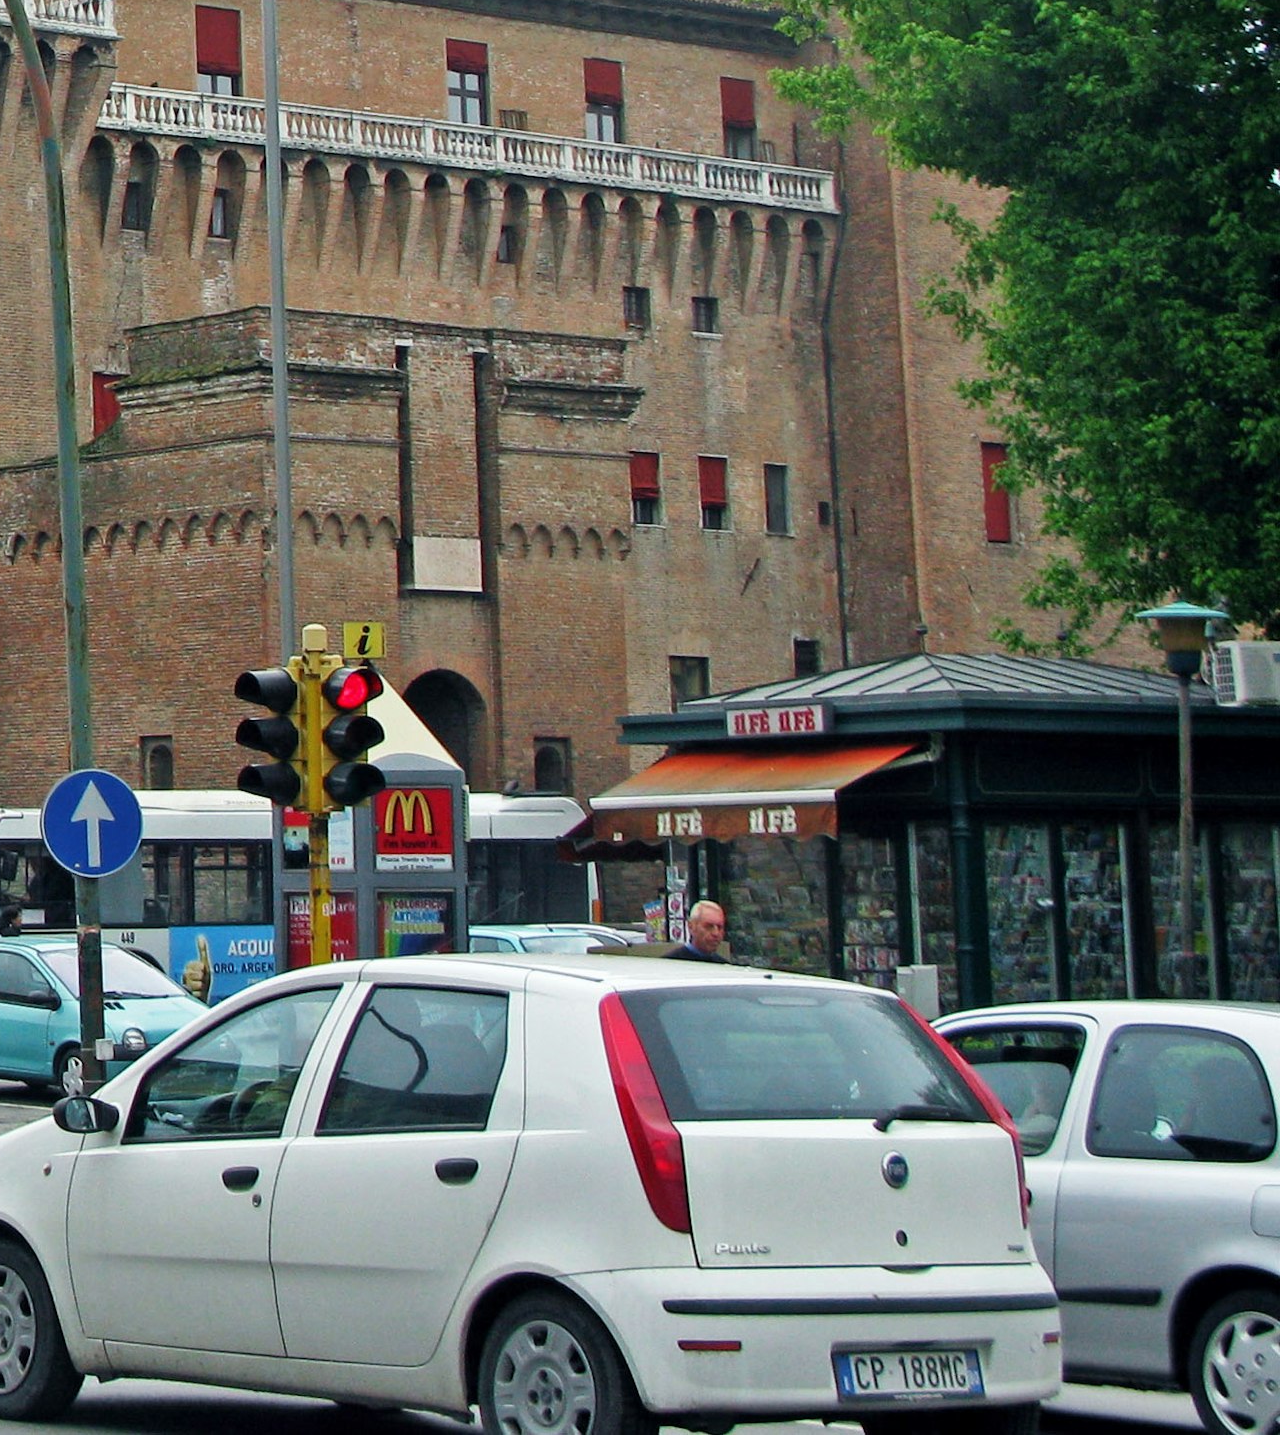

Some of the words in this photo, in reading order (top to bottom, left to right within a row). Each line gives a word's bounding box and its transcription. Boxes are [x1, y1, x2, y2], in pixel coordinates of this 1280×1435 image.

[121, 932, 135, 944] 449
[214, 963, 238, 974] ORO,
[715, 1243, 771, 1255] Punto
[854, 1356, 885, 1389] CP
